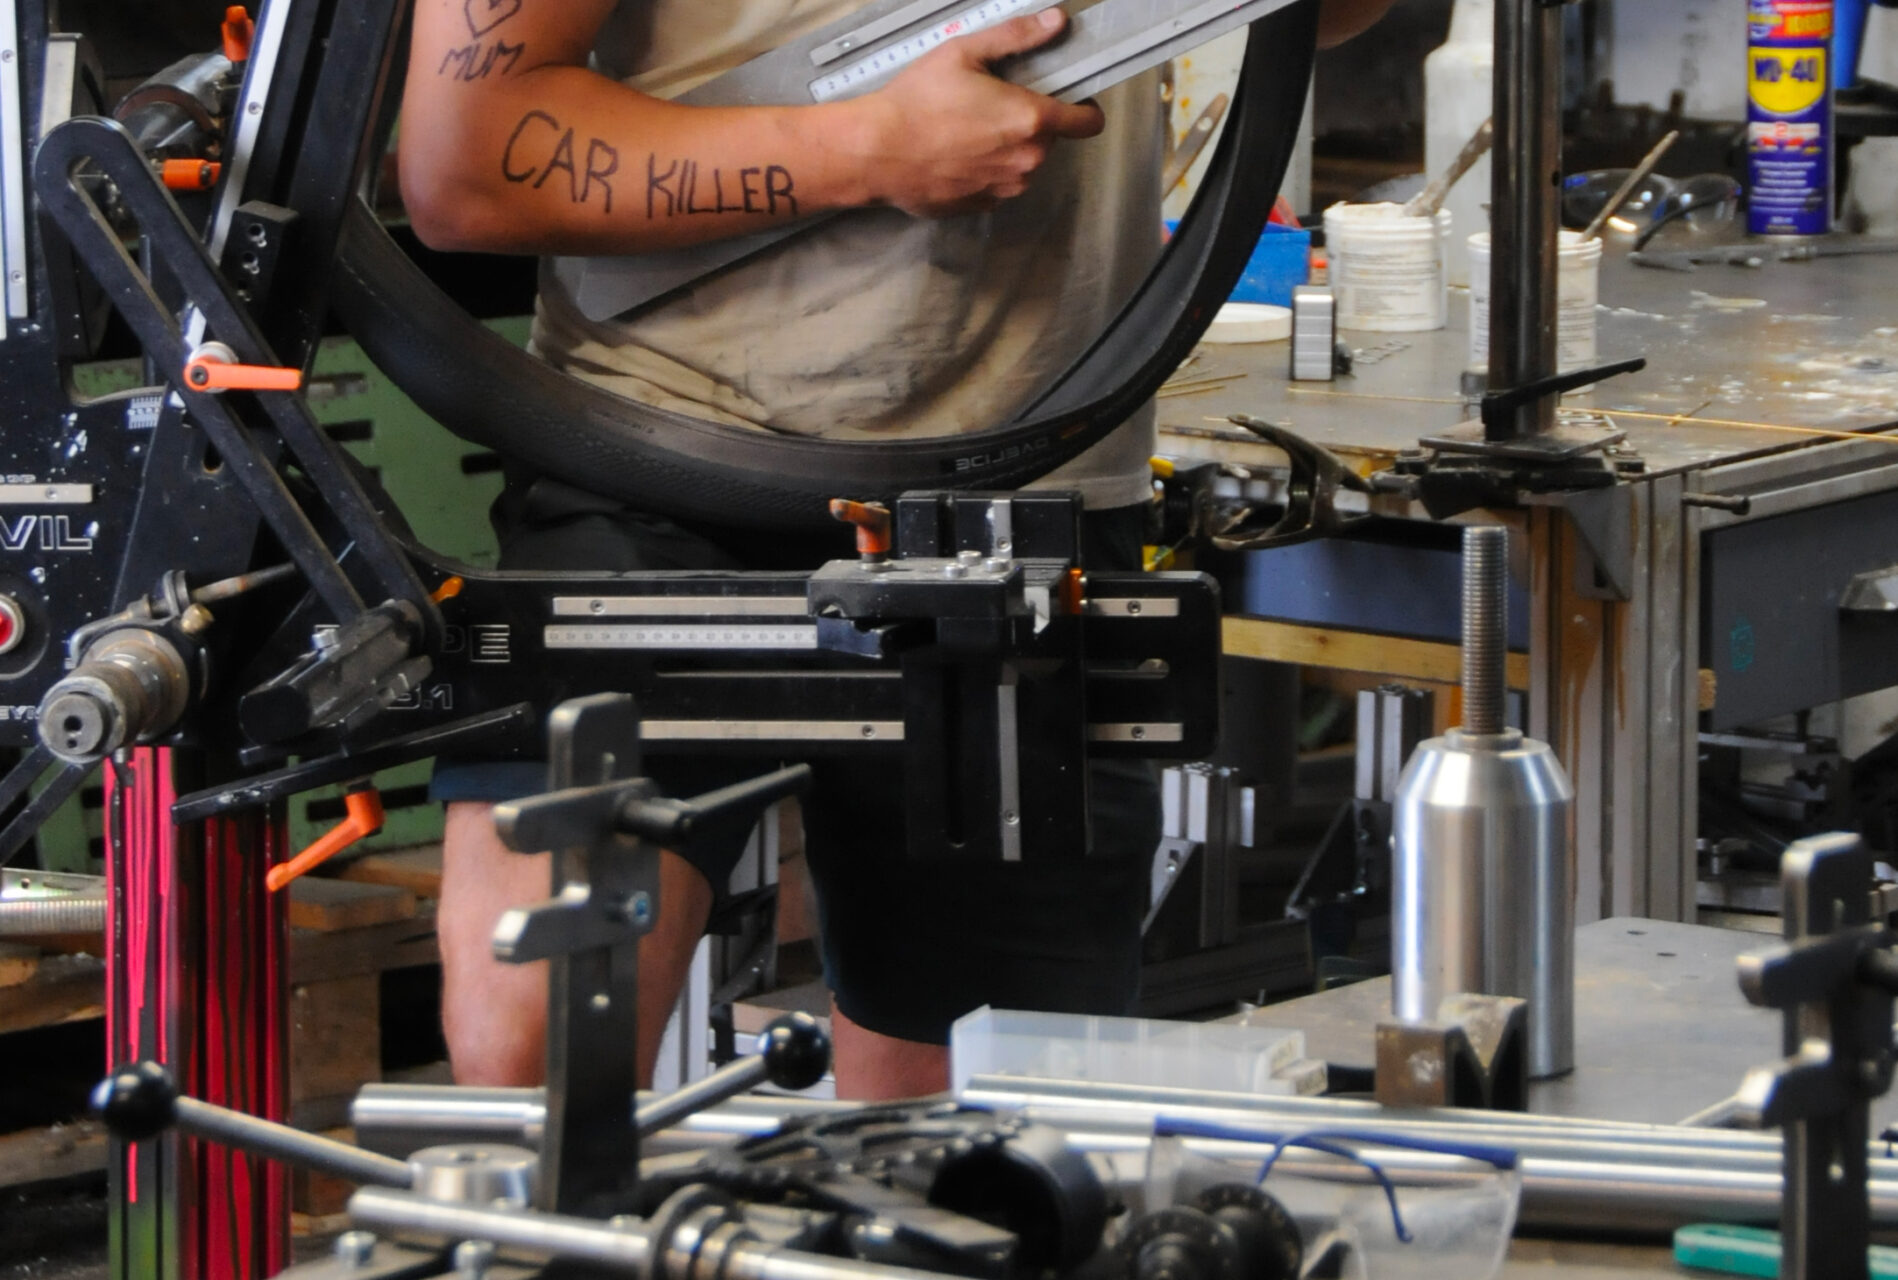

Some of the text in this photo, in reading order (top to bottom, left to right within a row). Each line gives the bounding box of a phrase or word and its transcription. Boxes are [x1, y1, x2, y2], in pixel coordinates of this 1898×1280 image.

[437, 41, 525, 81] MUM
[502, 110, 798, 219] CAR KILLER
